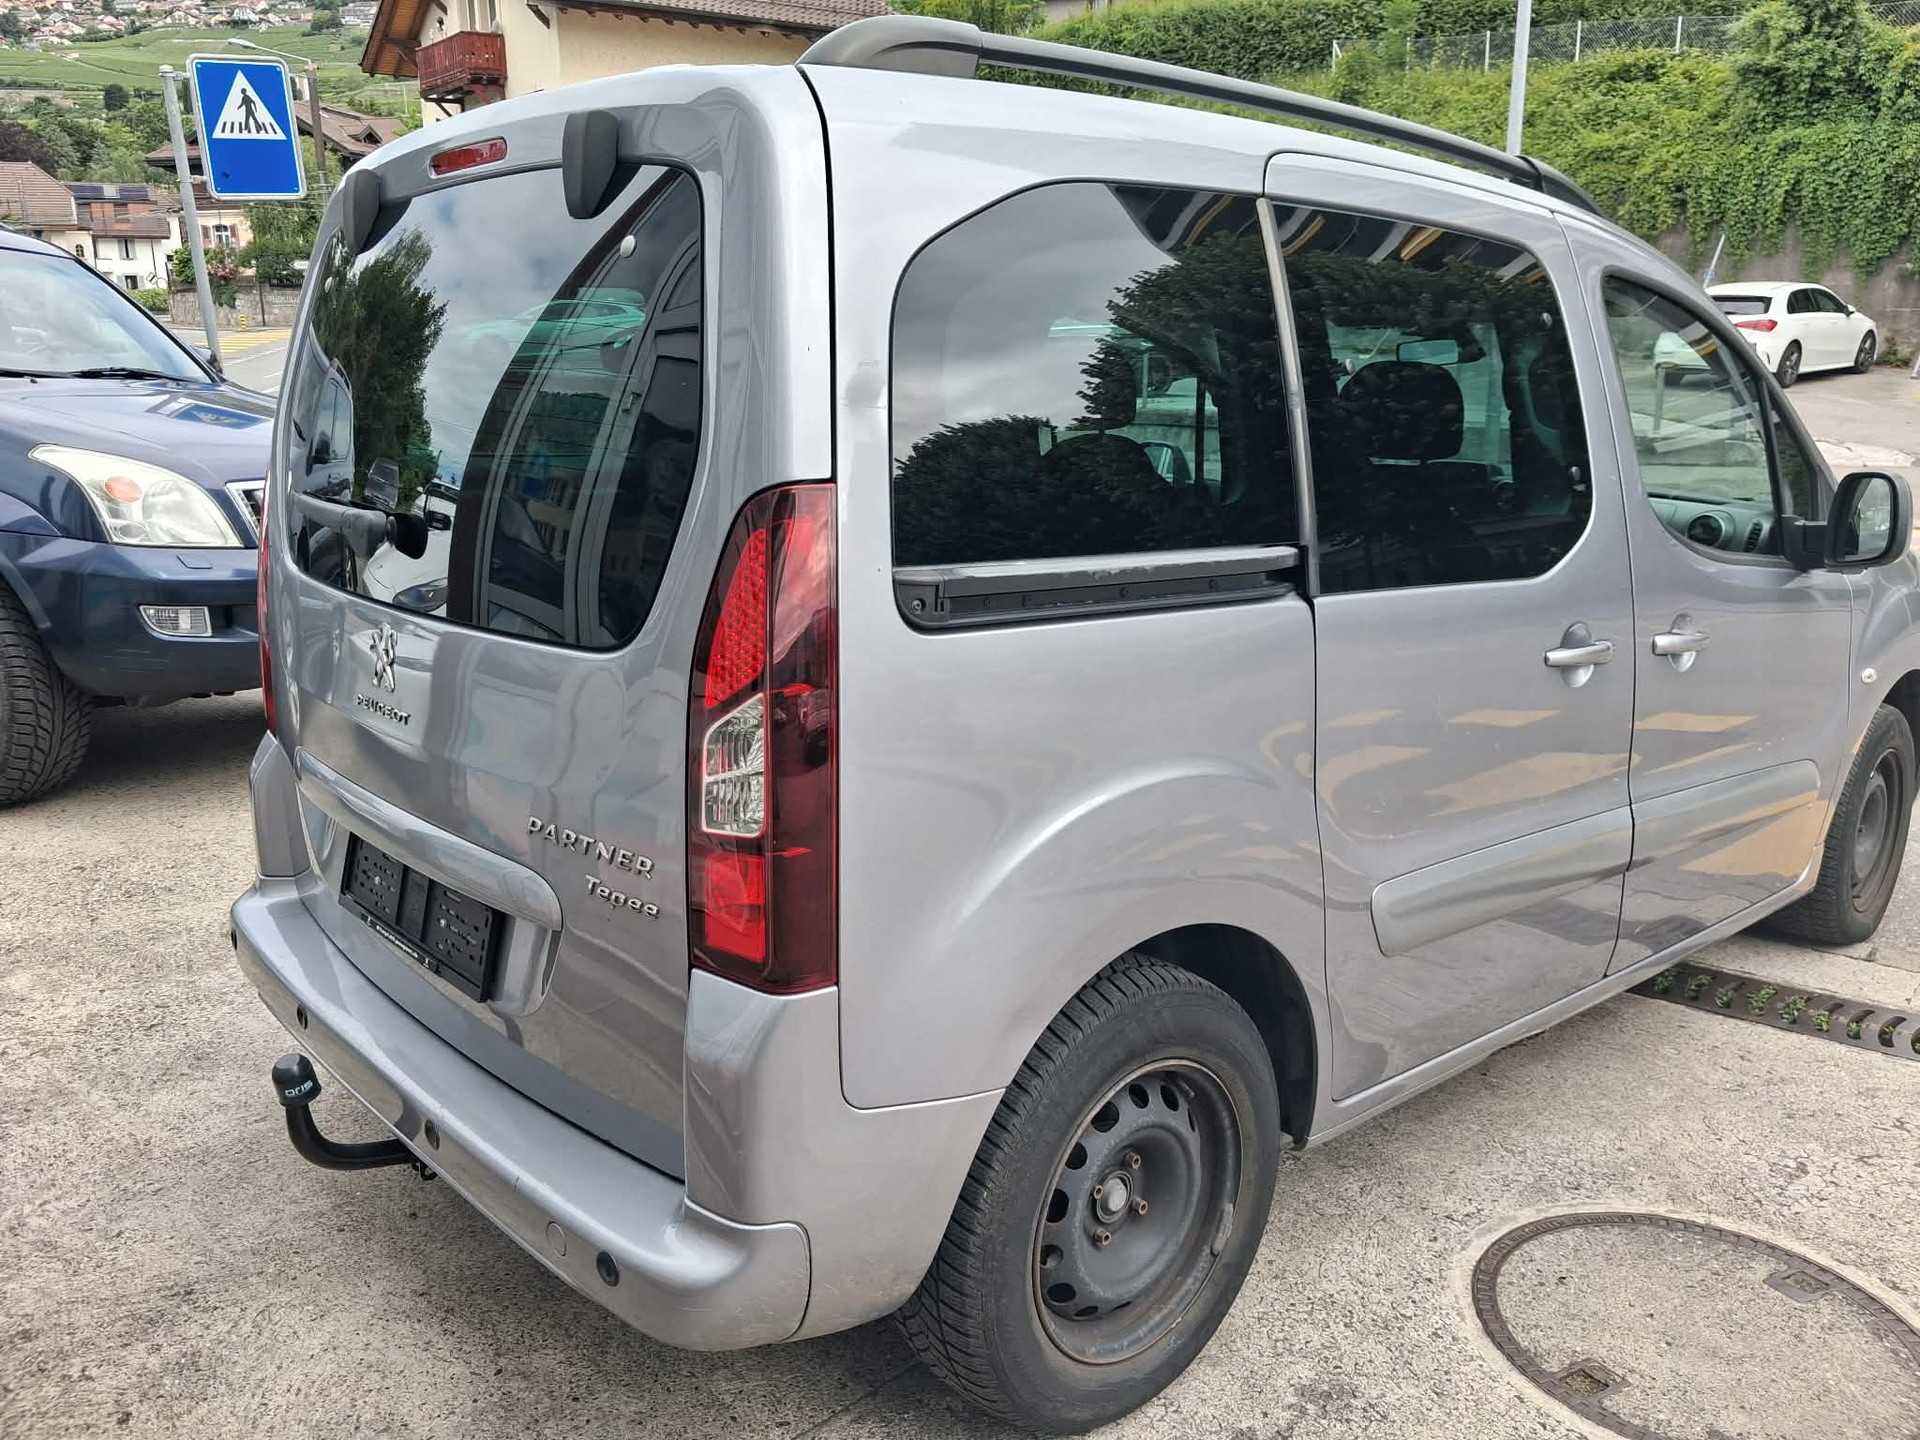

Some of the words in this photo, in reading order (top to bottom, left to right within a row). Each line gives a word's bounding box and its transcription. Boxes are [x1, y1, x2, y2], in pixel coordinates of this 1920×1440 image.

[357, 693, 411, 726] PEUGEOT
[526, 815, 655, 880] PARTNER
[585, 873, 660, 919] Tepee
